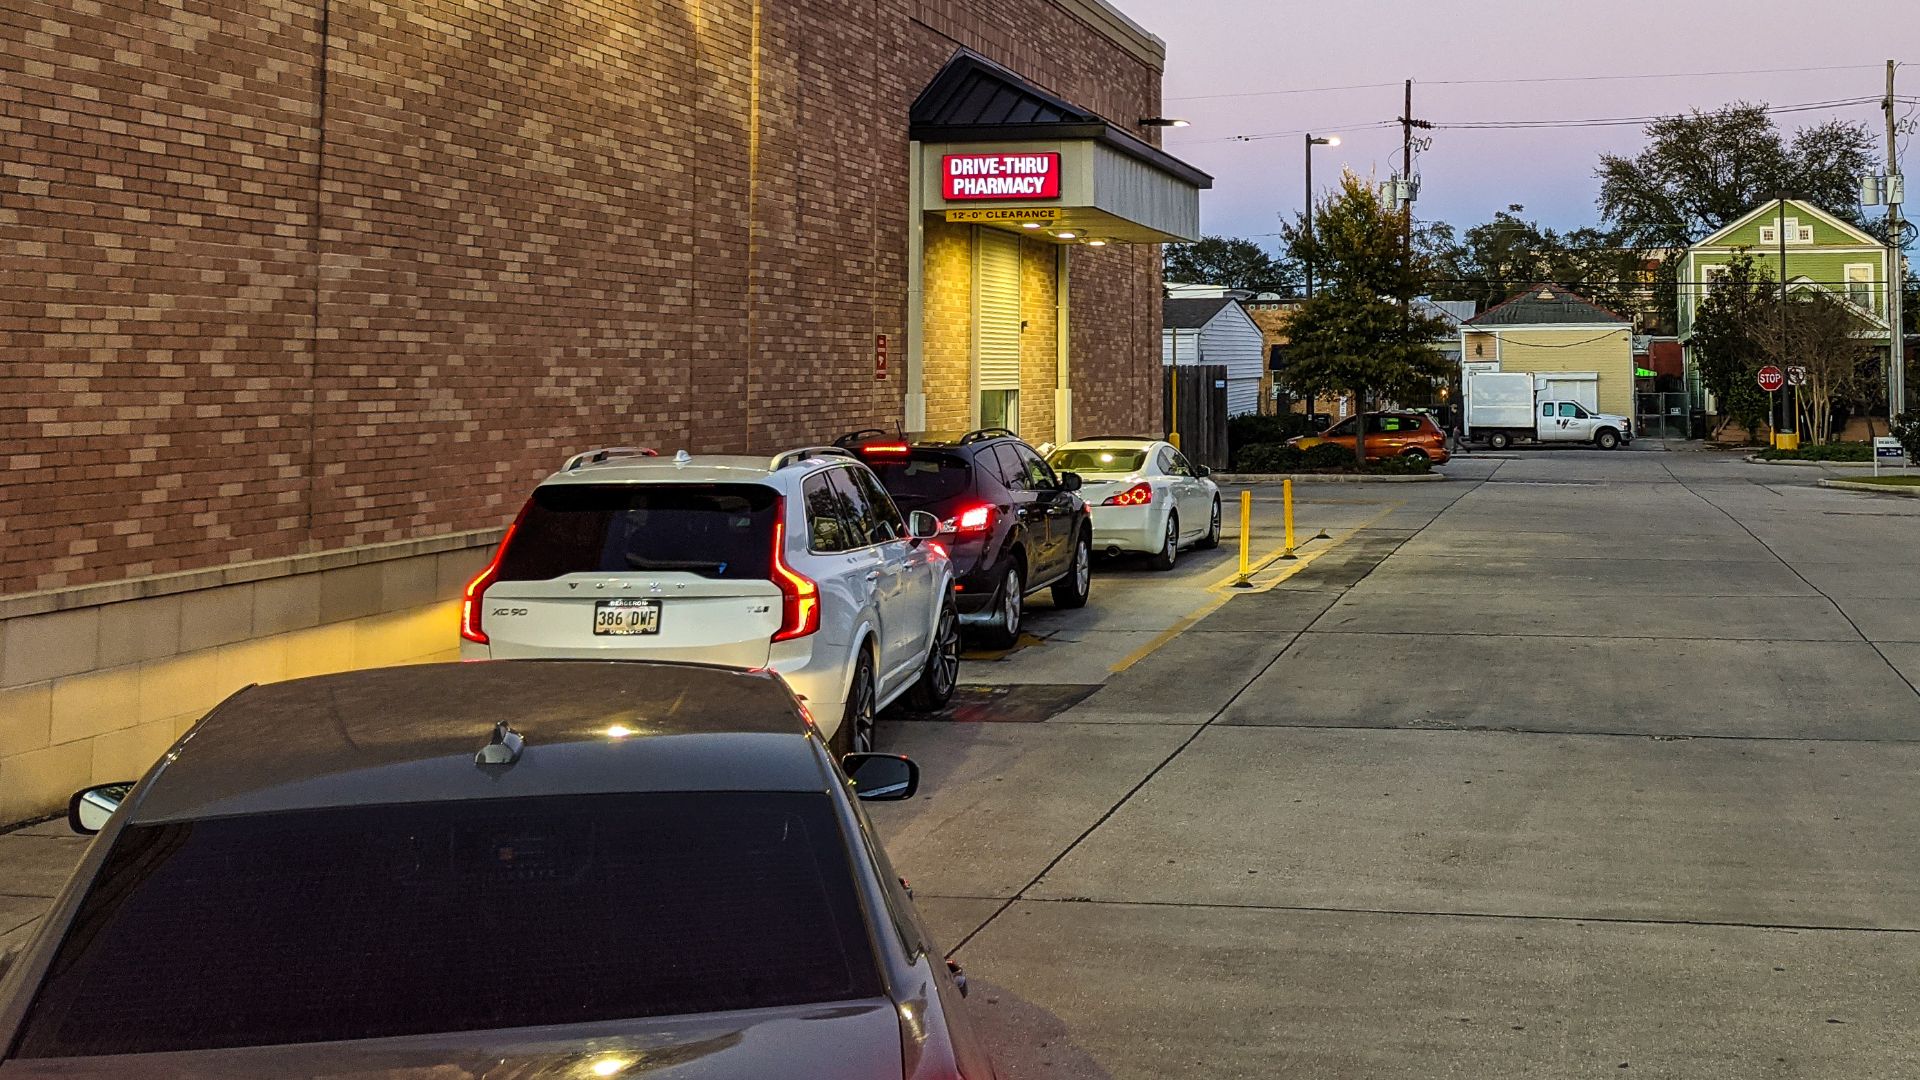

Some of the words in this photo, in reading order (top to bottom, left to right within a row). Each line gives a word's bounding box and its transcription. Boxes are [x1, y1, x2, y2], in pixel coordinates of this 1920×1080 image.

[950, 157, 1049, 175] DRIVE-THRU
[953, 177, 1045, 195] PHARMACY
[985, 210, 1055, 219] CLEARANCE
[1759, 373, 1781, 383] STOP
[598, 611, 623, 626] 386
[631, 610, 657, 626] DWF
